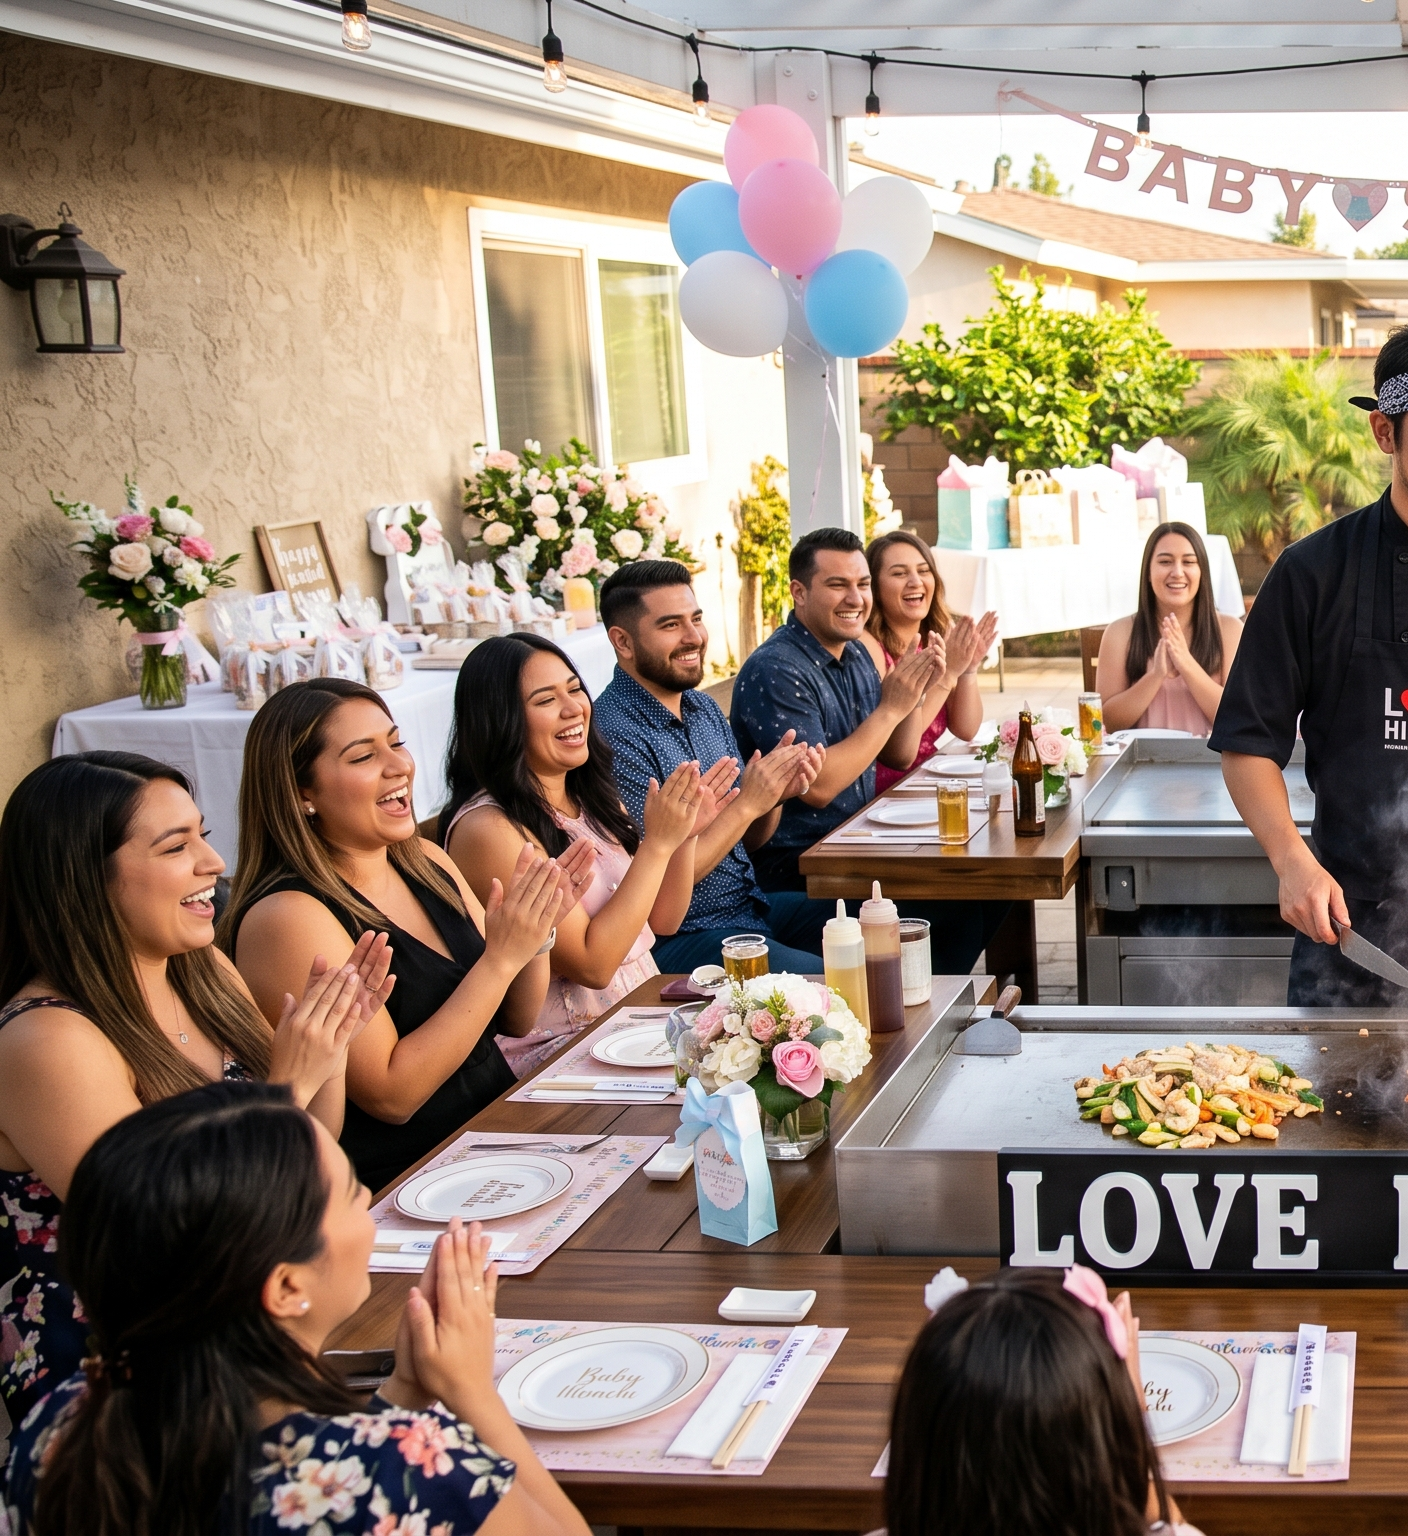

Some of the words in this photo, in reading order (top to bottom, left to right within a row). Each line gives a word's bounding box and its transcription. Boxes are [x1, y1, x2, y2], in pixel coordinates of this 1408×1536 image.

[1084, 122, 1317, 226] BABY
[1007, 1170, 1319, 1270] LOVE
[575, 1367, 645, 1392] Baby
